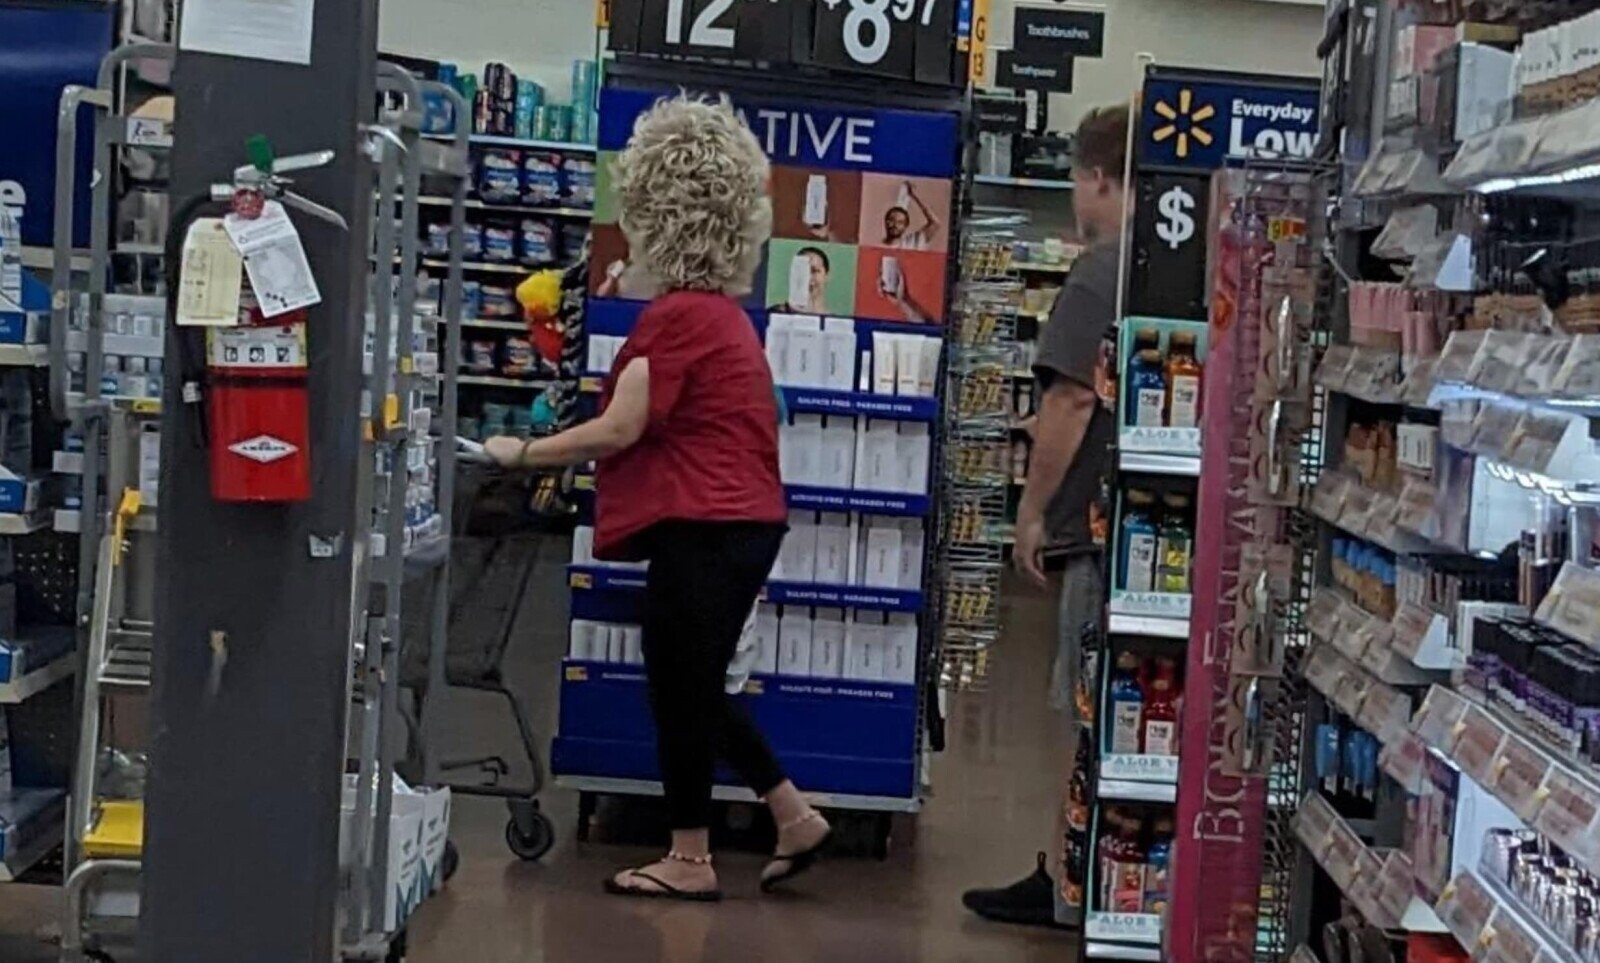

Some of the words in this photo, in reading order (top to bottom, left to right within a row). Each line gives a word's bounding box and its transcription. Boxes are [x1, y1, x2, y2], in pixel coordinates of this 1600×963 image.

[975, 16, 986, 42] G
[1027, 23, 1090, 39] Toothbrushes
[1231, 98, 1314, 125] Everyday
[737, 107, 875, 163] TIVE
[1229, 116, 1321, 160] Low
[1156, 185, 1195, 249] $
[1134, 428, 1180, 439] ALOE
[1114, 756, 1161, 768] ALOE
[1099, 914, 1147, 926] ALOE
